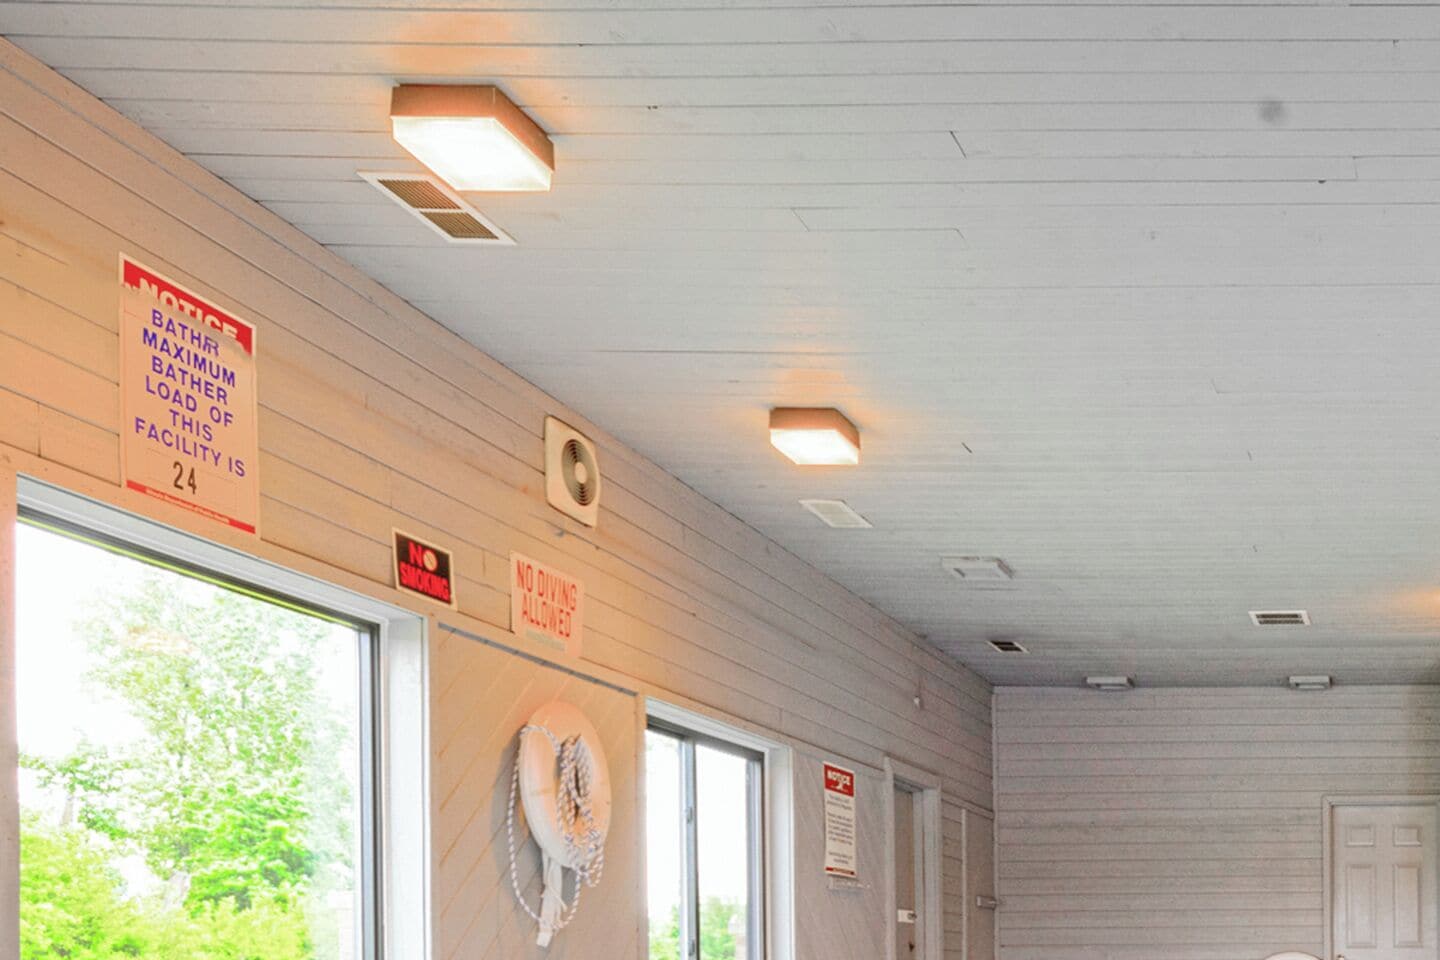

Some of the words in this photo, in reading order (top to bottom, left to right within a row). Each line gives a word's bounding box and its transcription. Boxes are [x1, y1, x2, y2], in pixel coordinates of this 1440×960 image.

[142, 328, 236, 388] MAXIMUM
[152, 355, 228, 405] BATHER
[146, 375, 198, 412] LOAD
[209, 406, 233, 427] OF
[169, 409, 213, 442] THIS
[135, 416, 222, 467] FACILITY
[228, 456, 246, 477] IS
[173, 461, 197, 495] 24
[400, 560, 450, 601] SMOKING
[516, 559, 533, 593] NO
[537, 569, 577, 611] DIVING
[522, 592, 571, 638] ALLOWED
